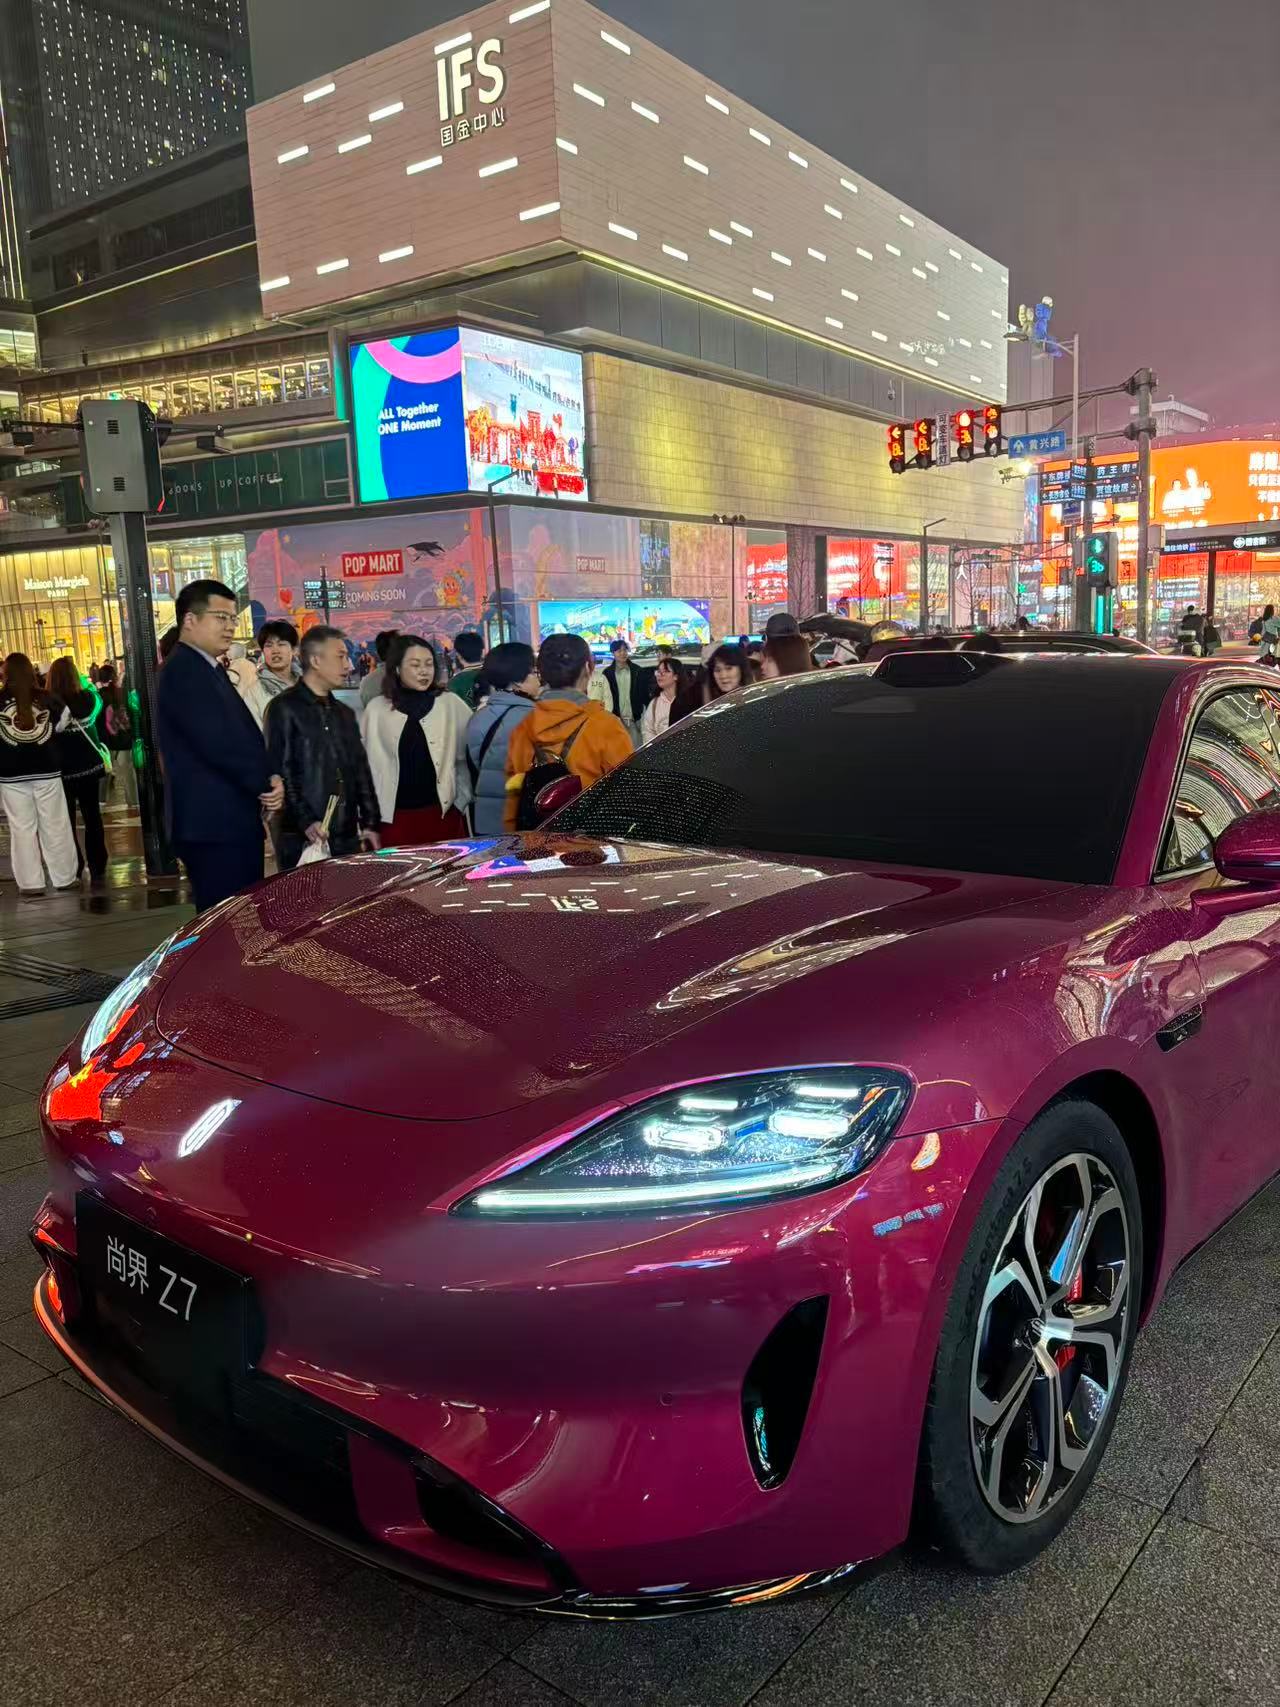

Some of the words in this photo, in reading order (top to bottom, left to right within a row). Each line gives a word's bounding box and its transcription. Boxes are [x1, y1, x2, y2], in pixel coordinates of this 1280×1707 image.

[437, 38, 504, 121] IFS
[440, 107, 505, 147] 国金中心
[377, 407, 395, 420] ALL
[396, 401, 439, 419] Together
[377, 421, 400, 435] ONE
[401, 415, 442, 432] Moment
[1028, 436, 1060, 451] 黄兴路
[219, 479, 233, 489] UP
[344, 556, 367, 574] POP
[369, 553, 400, 573] MART
[577, 558, 588, 570] POP
[24, 577, 53, 590] Maison
[54, 574, 91, 589] Margiela
[345, 591, 380, 603] COMING
[381, 588, 407, 601] SOON
[107, 1235, 150, 1294] 尚界
[159, 1264, 197, 1321] Z7
